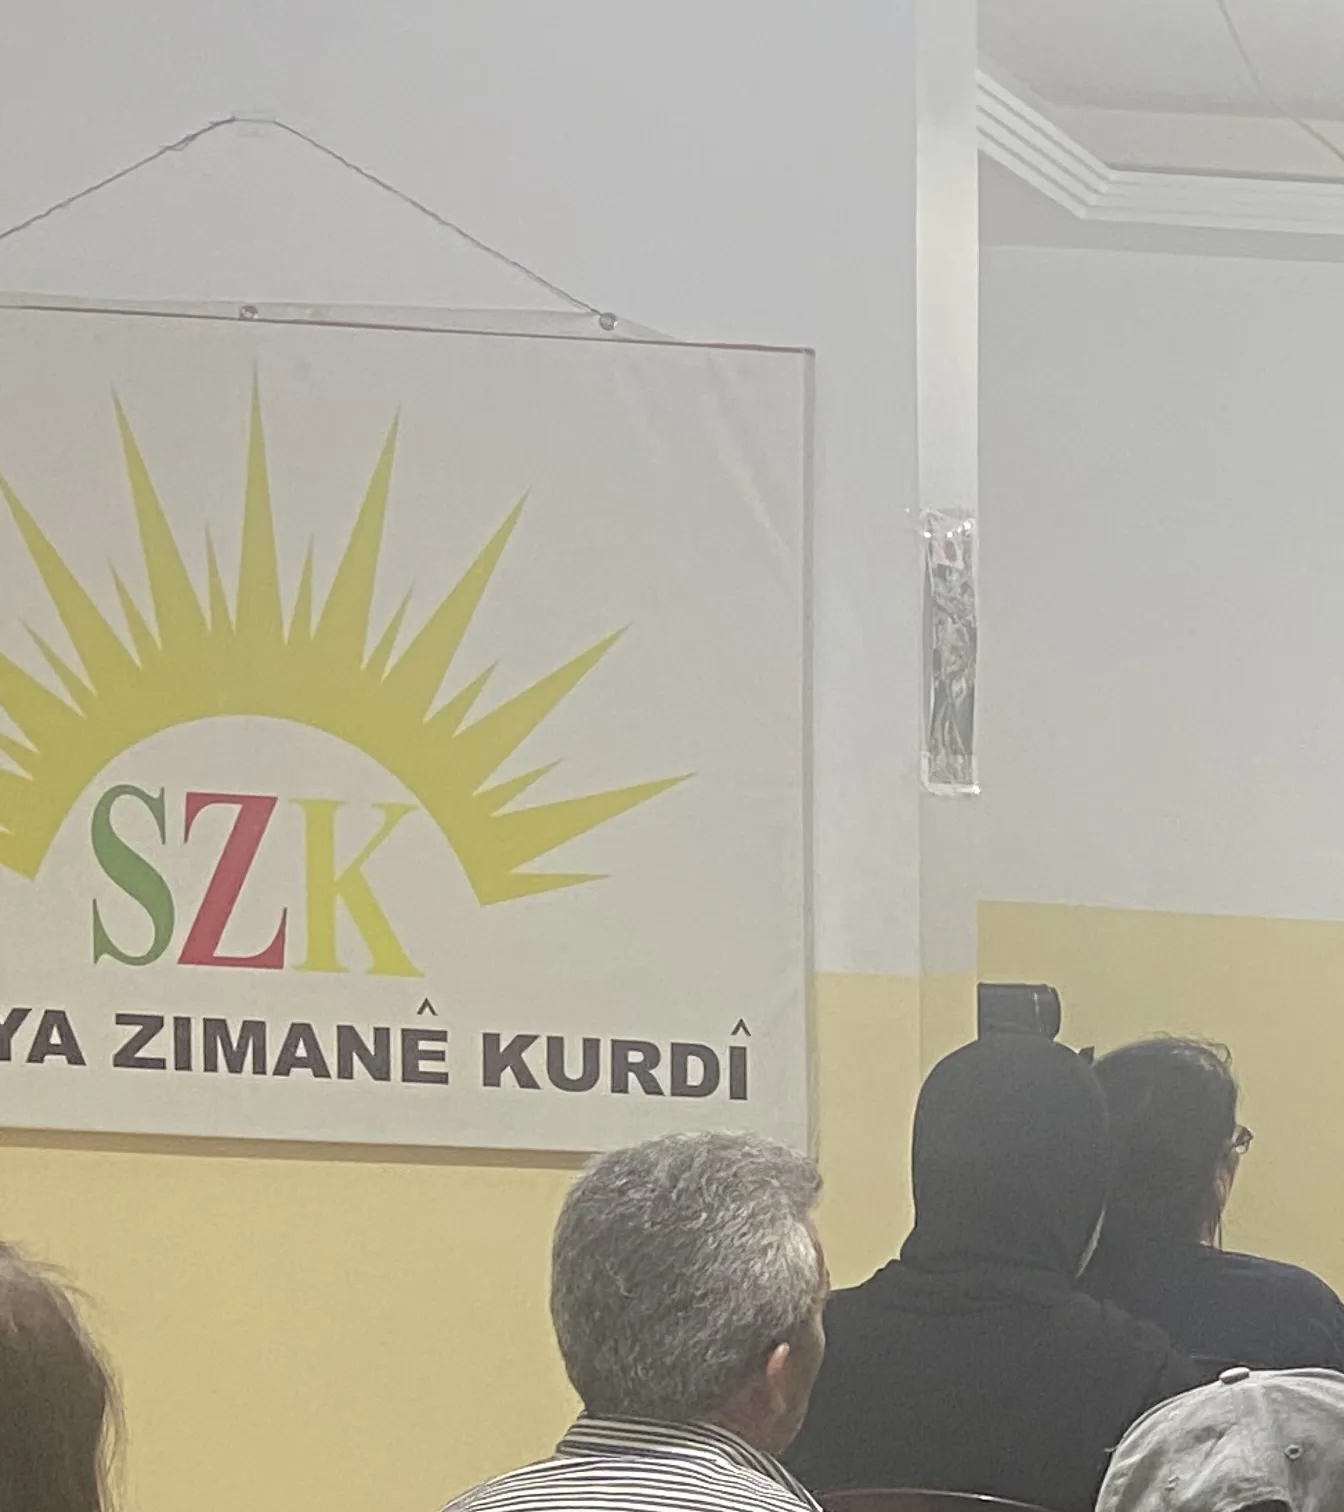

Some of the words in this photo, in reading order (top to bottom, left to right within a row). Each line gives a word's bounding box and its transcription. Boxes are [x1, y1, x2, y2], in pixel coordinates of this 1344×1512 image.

[90, 783, 426, 978] SZK
[113, 998, 450, 1086] ZIMANÊ
[481, 1018, 753, 1102] KURDÎ
